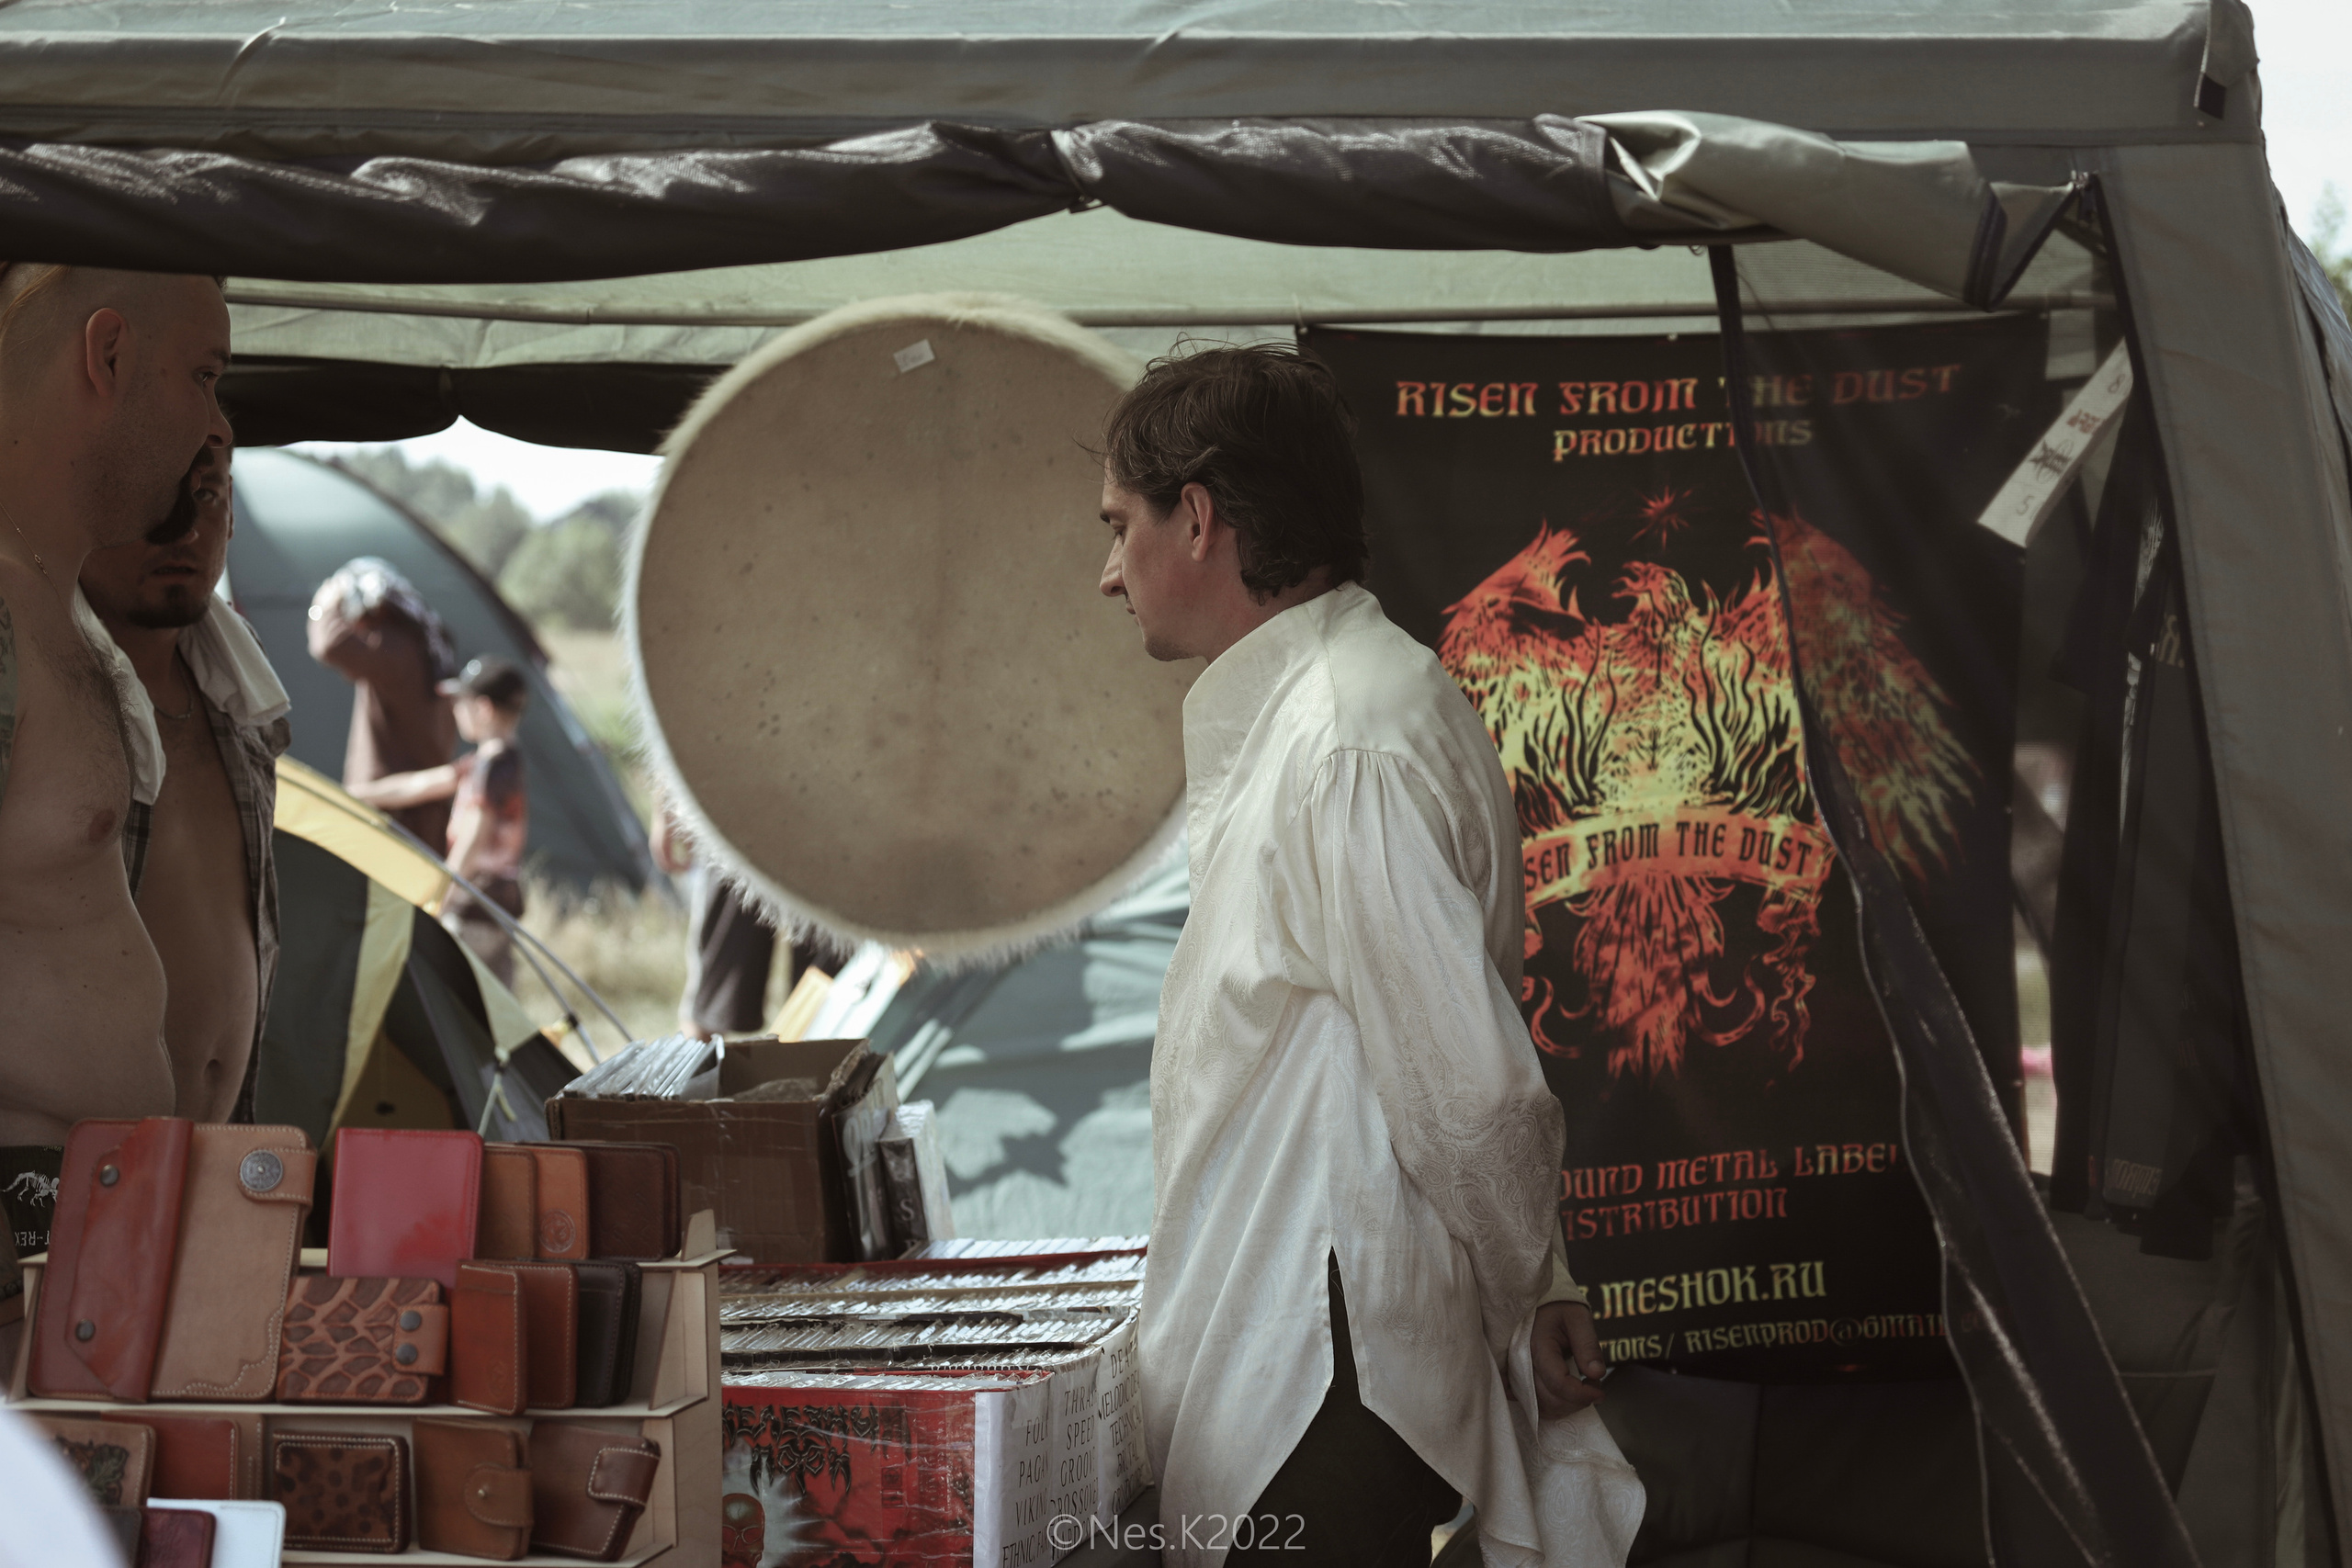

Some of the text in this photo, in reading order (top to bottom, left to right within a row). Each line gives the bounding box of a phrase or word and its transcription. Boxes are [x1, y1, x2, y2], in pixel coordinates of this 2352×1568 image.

[1396, 363, 1962, 418] RISEN FROM HE DUST
[1553, 419, 1813, 463] PRODUCTINS
[1586, 821, 1660, 870] FROM
[1676, 821, 1726, 857] THE
[1738, 827, 1814, 876] DUST
[1657, 1149, 1780, 1191] METAL
[1577, 1260, 1827, 1321] .MESHOK.RU
